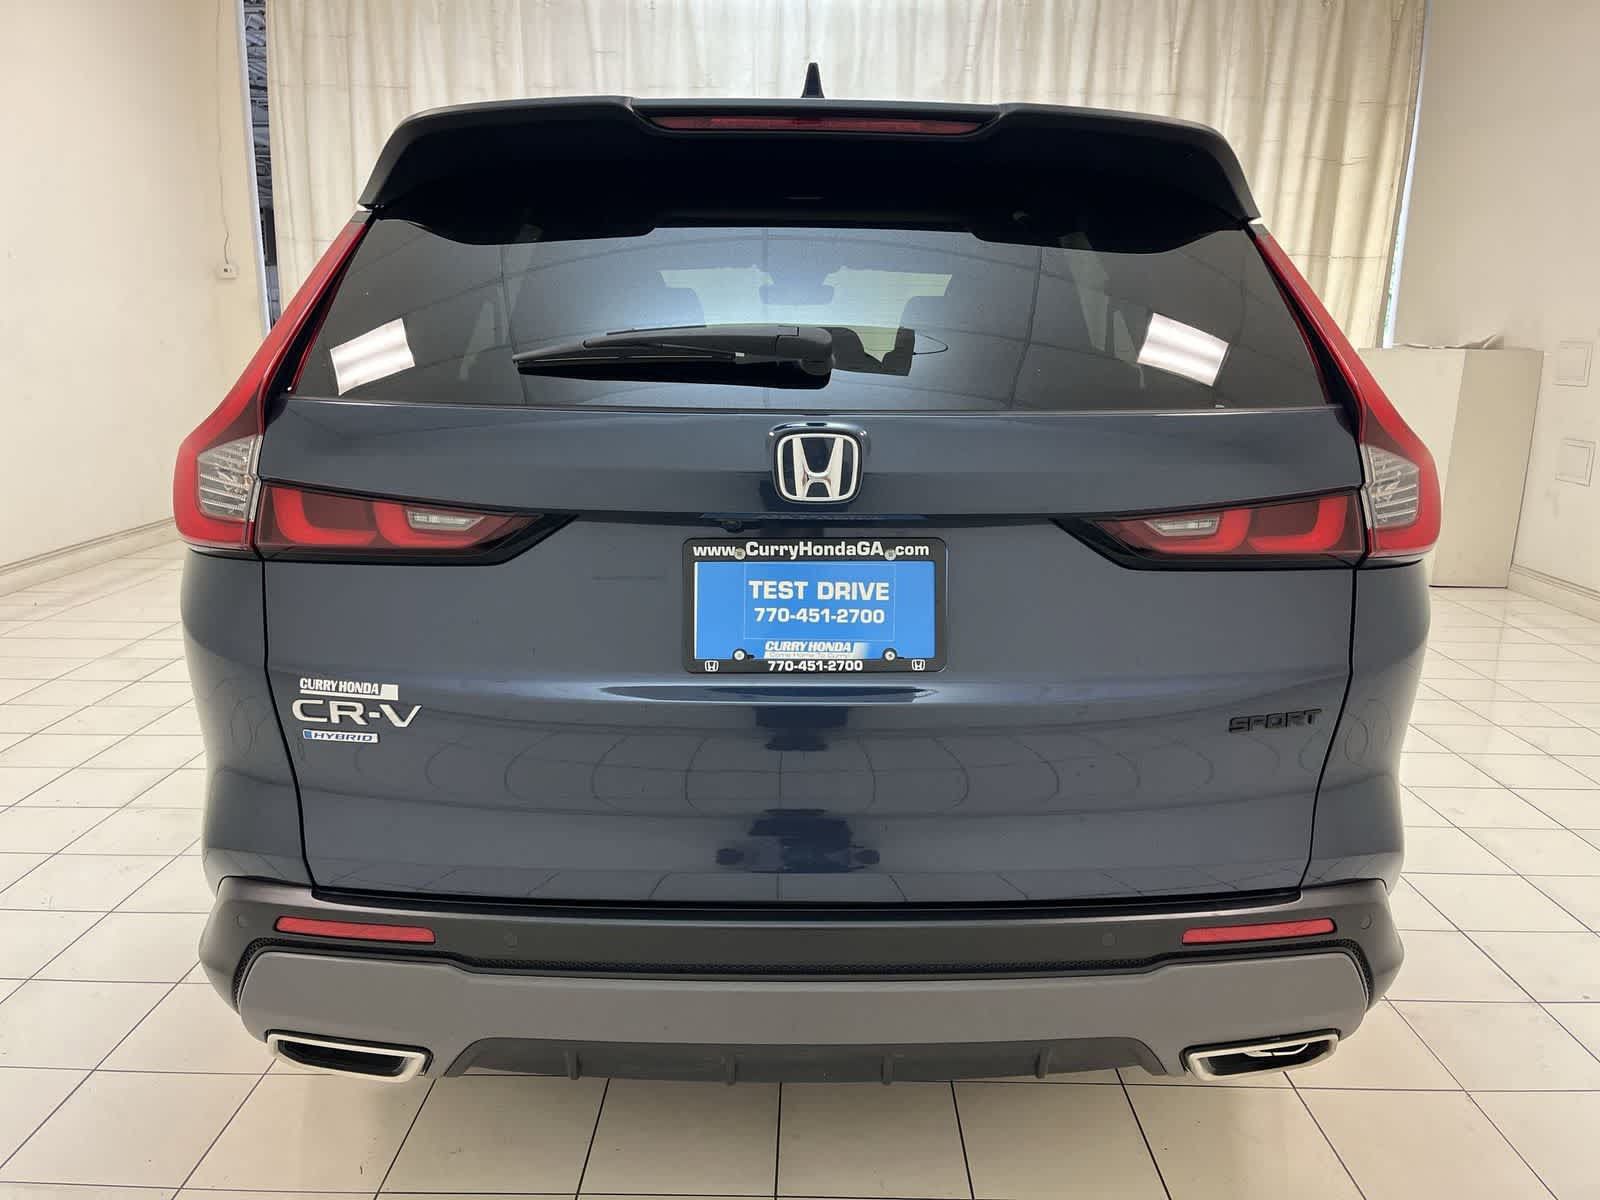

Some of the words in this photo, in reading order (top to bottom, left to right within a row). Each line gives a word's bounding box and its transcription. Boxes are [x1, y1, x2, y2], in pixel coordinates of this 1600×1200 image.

[692, 541, 930, 560] wwwCurryHondaGAcom
[748, 580, 809, 600] TEST
[817, 582, 890, 601] DRIVE
[753, 607, 886, 624] 770-451-2700
[764, 641, 808, 651] CURRY
[807, 641, 852, 652] HONDA
[767, 660, 863, 671] 770-451-2700
[300, 677, 338, 691] CURRY
[339, 680, 380, 695] HONDA
[291, 699, 422, 728] CR-V
[1228, 708, 1322, 734] SPORT
[313, 731, 374, 742] HYBRID
